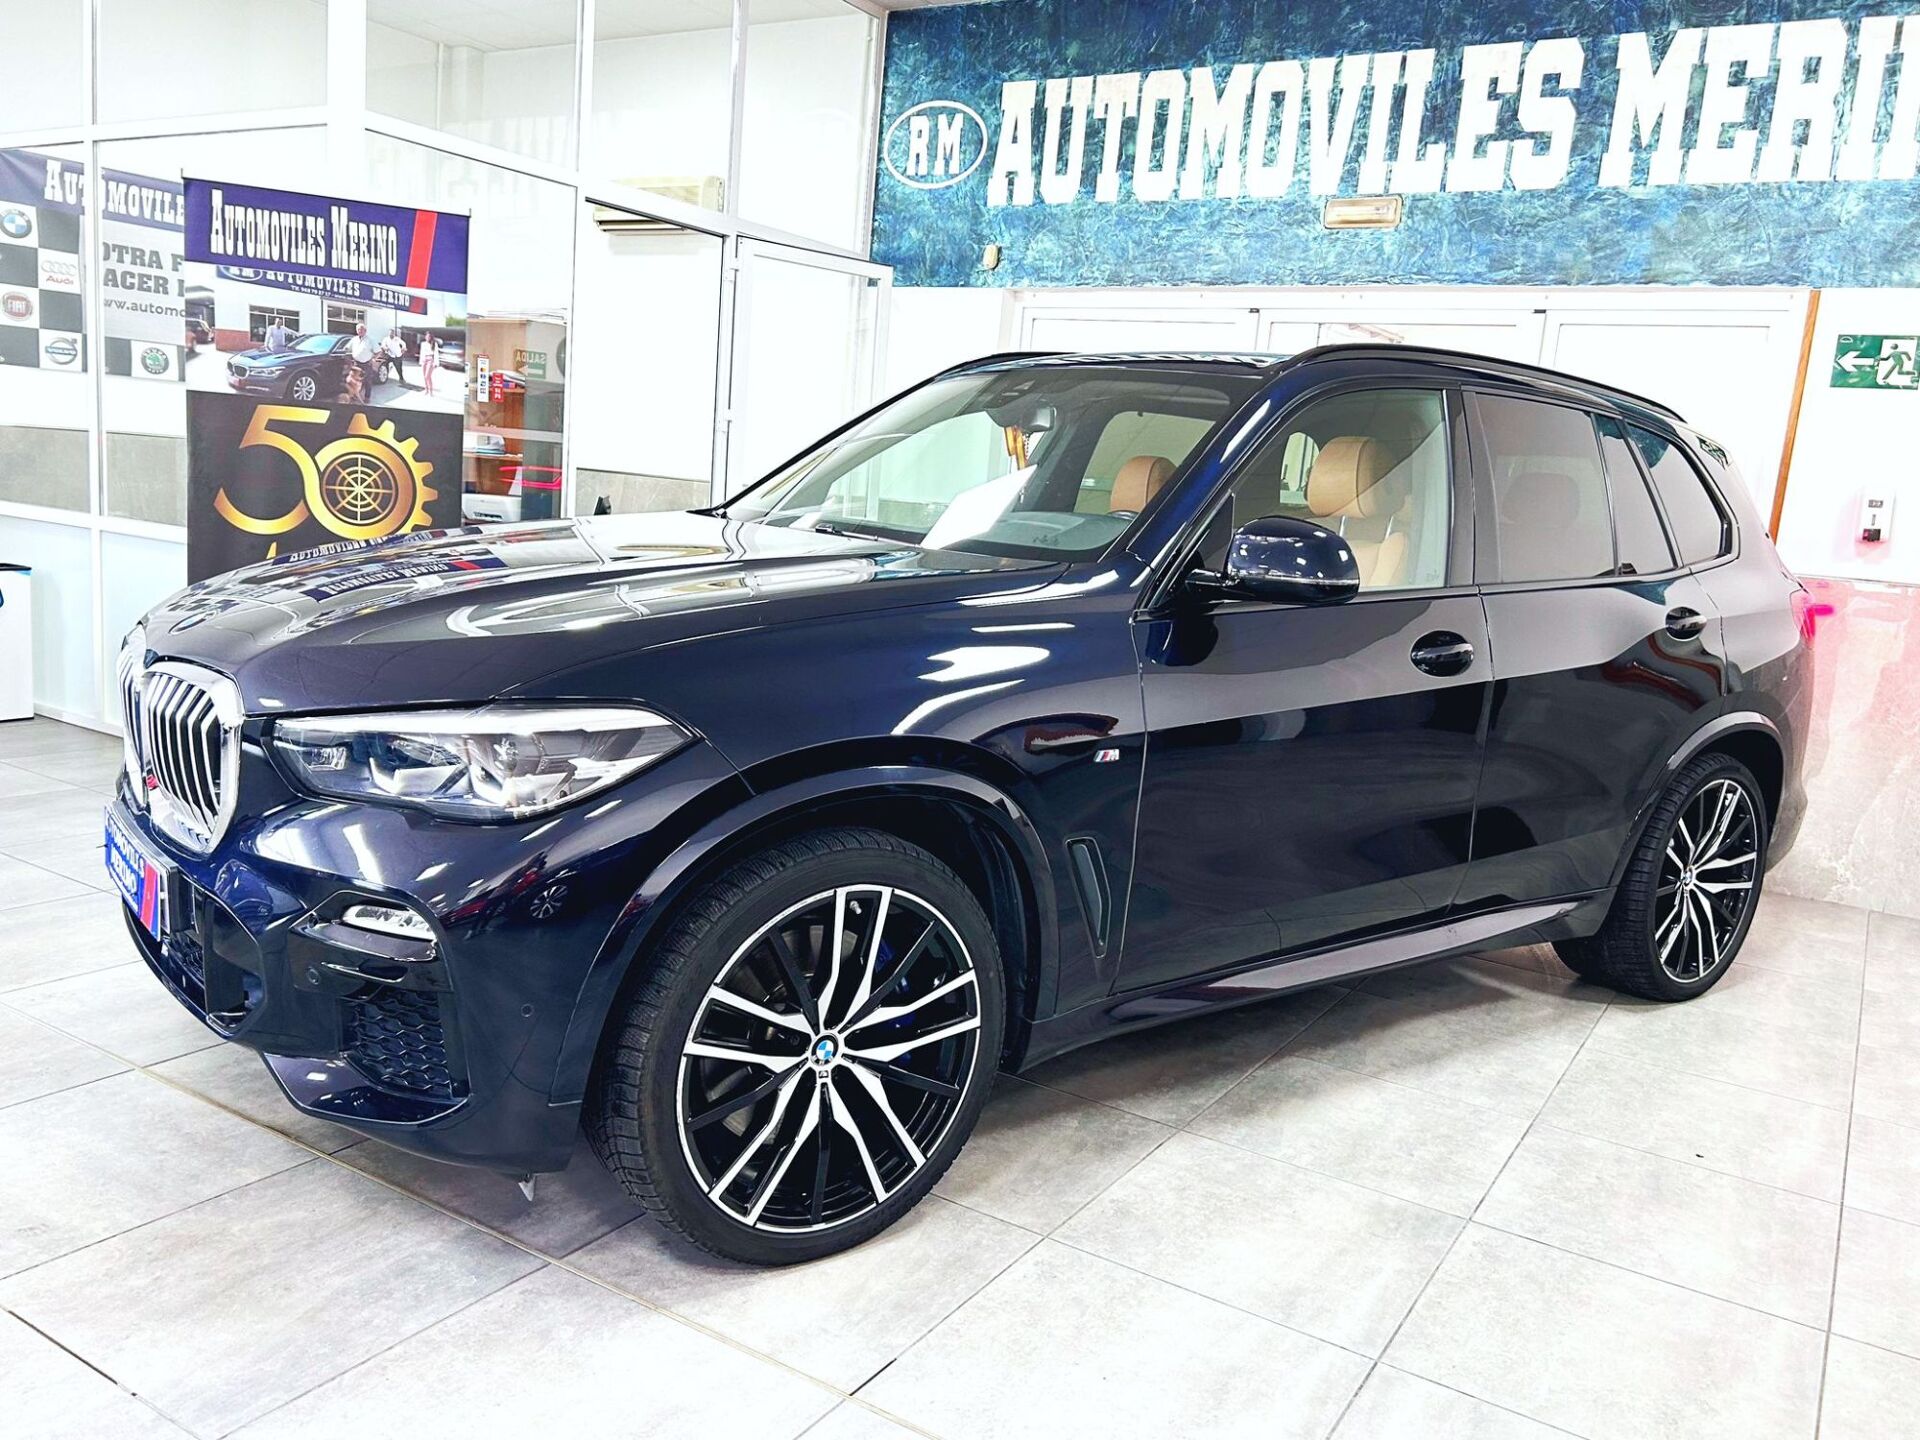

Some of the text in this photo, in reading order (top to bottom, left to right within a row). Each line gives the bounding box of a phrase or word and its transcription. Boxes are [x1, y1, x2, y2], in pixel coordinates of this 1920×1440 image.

[906, 113, 964, 176] RM
[987, 37, 1585, 208] AUTOMOVILES
[210, 188, 398, 277] AUTOMOVILES MERINO
[372, 287, 410, 306] MERINO
